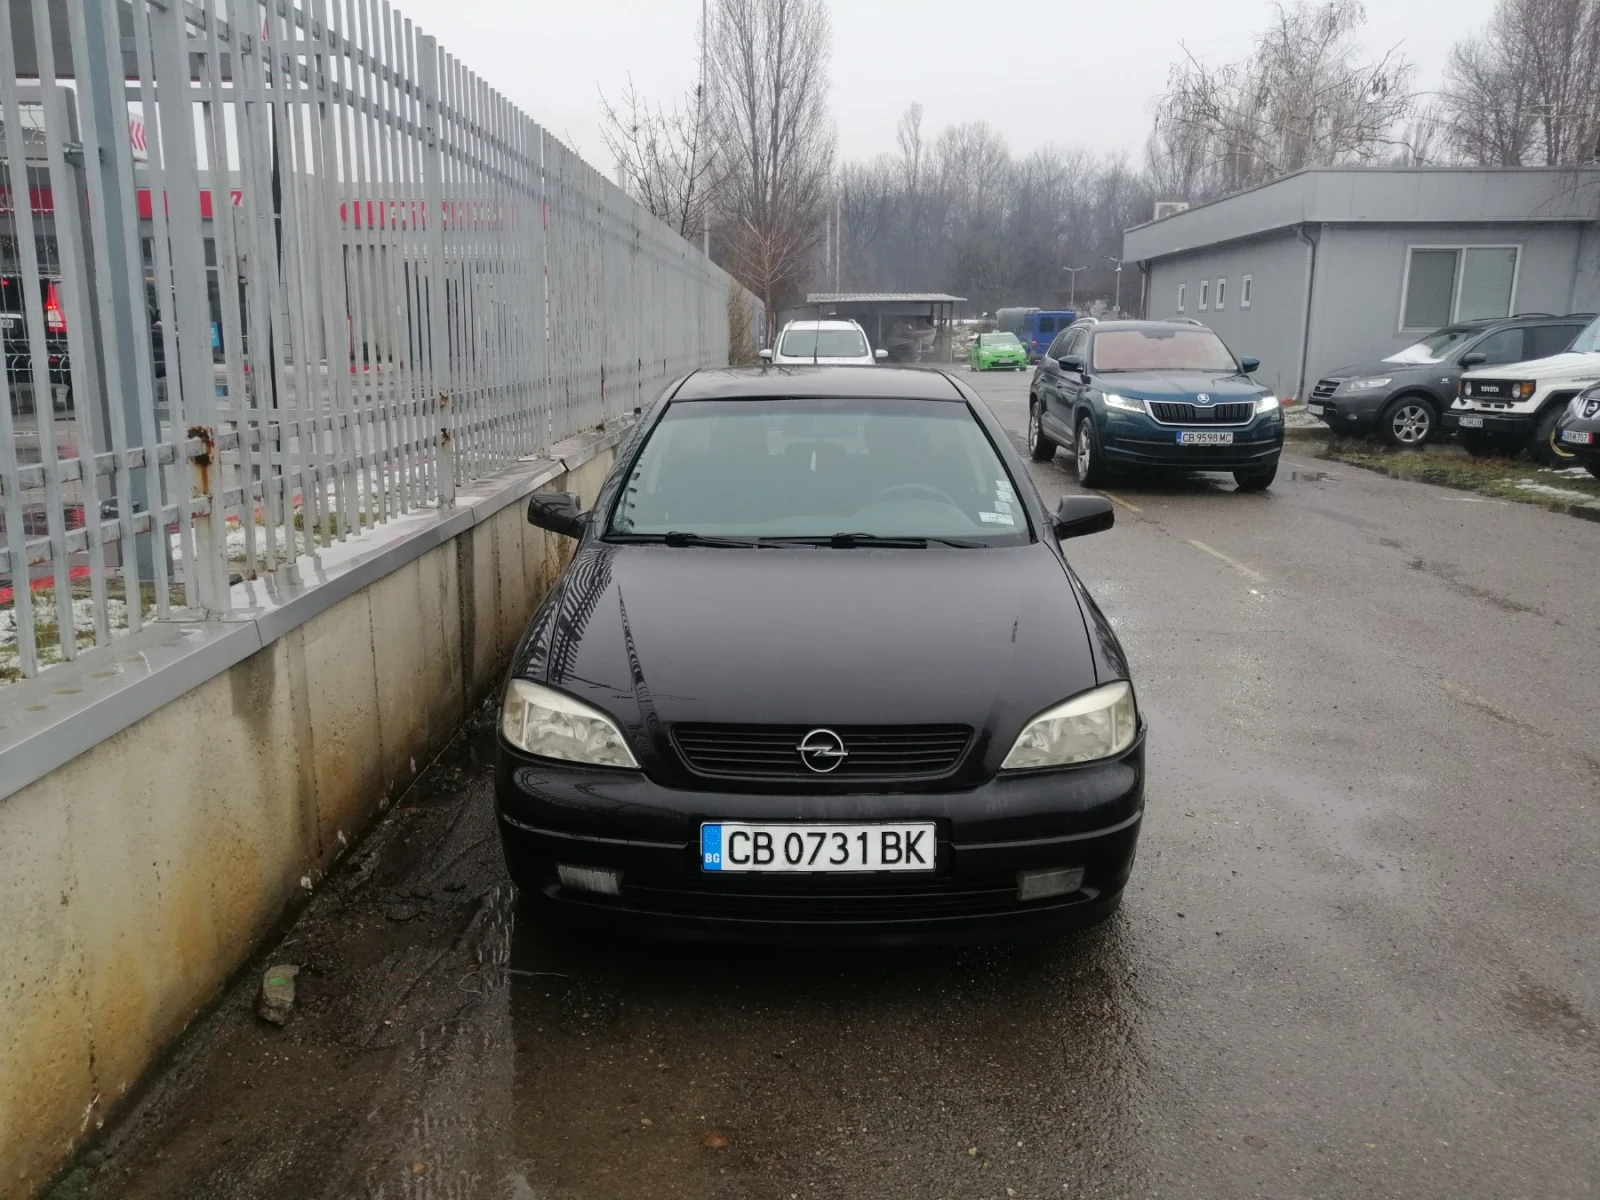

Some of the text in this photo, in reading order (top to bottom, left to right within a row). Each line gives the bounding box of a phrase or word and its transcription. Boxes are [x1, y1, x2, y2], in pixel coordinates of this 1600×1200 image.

[1182, 433, 1232, 443] CB 9598 MC
[728, 830, 927, 865] CB 0731 BK
[705, 852, 720, 864] BG
